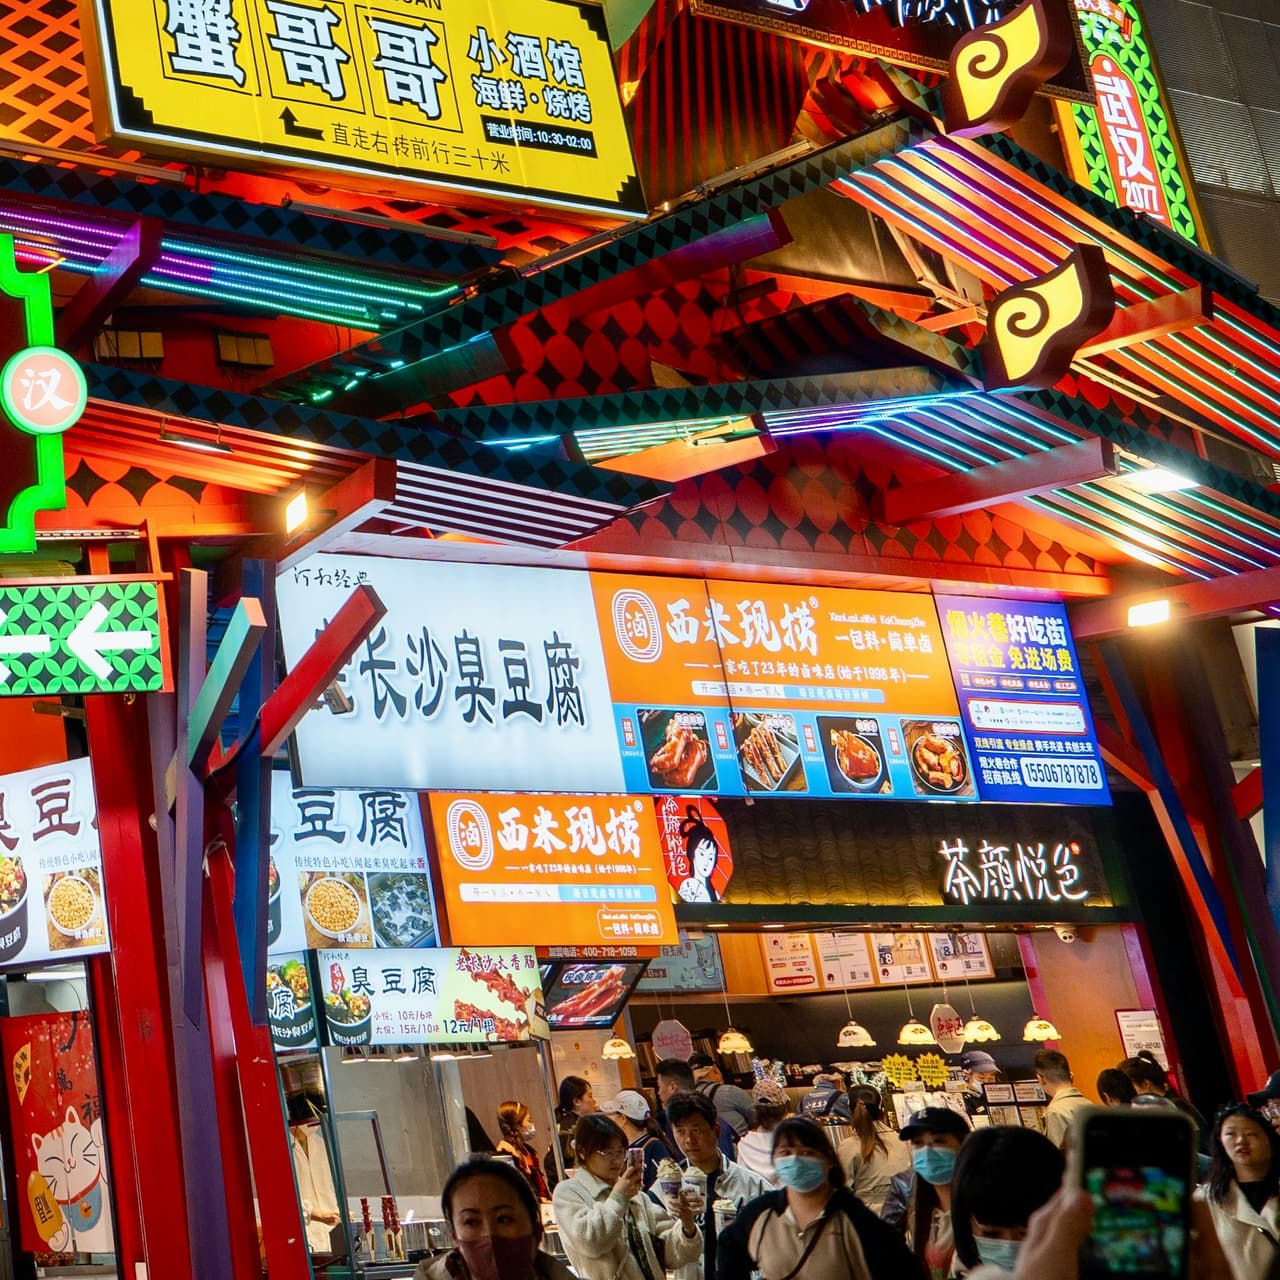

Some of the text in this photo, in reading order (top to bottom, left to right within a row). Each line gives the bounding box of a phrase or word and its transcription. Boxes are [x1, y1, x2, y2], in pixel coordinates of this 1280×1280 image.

[466, 26, 585, 88] 小酒馆
[1094, 73, 1155, 182] 武汉
[17, 365, 76, 416] 汉
[946, 609, 1068, 646] 烟火巷好吃街
[1008, 646, 1074, 672] 免进场费
[1025, 764, 1098, 785] 15506787878
[270, 791, 408, 849] 豆腐
[940, 837, 1089, 905] 茶颜悦色
[351, 965, 437, 997] 臭豆腐
